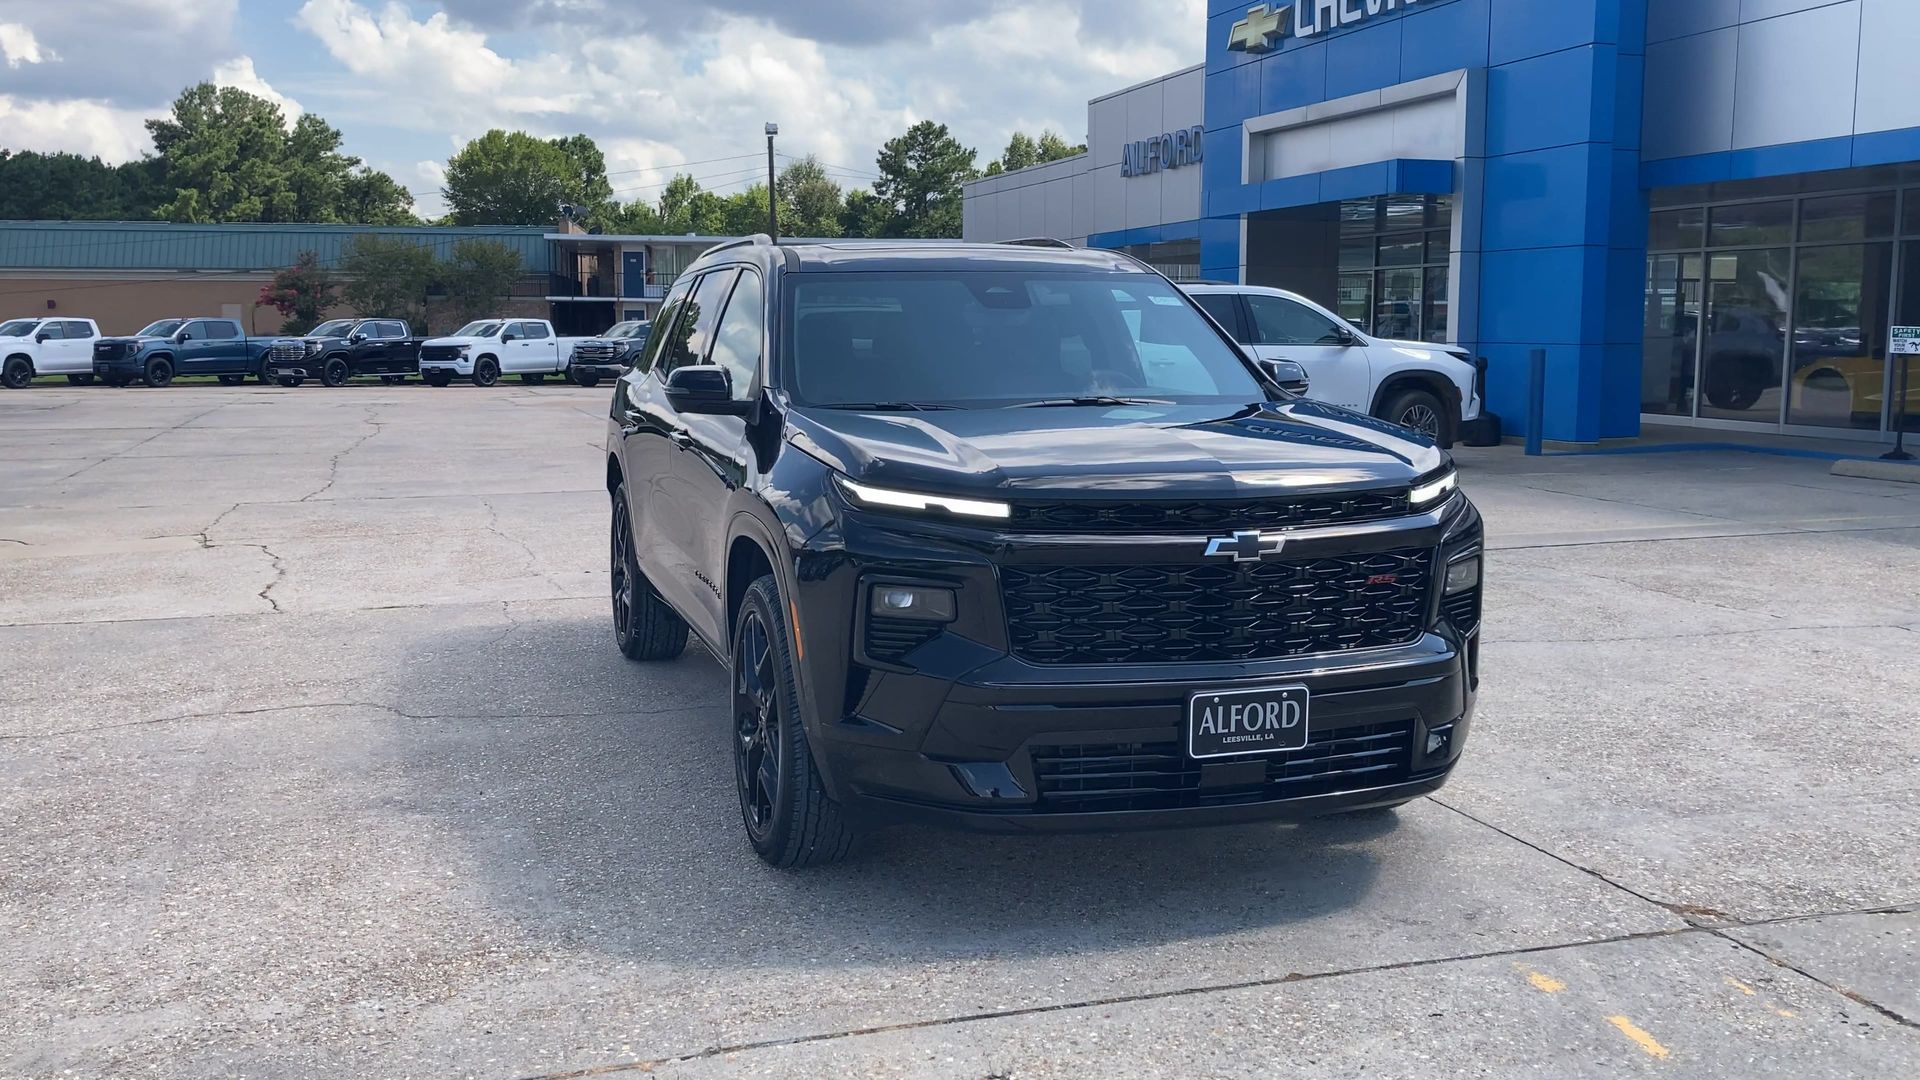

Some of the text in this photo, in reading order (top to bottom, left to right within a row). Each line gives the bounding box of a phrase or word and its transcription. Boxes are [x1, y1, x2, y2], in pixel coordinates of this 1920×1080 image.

[1120, 125, 1204, 177] ALFORD
[1367, 574, 1397, 585] RS
[1199, 700, 1300, 735] ALFORD
[1222, 734, 1263, 744] LEESVILLE,
